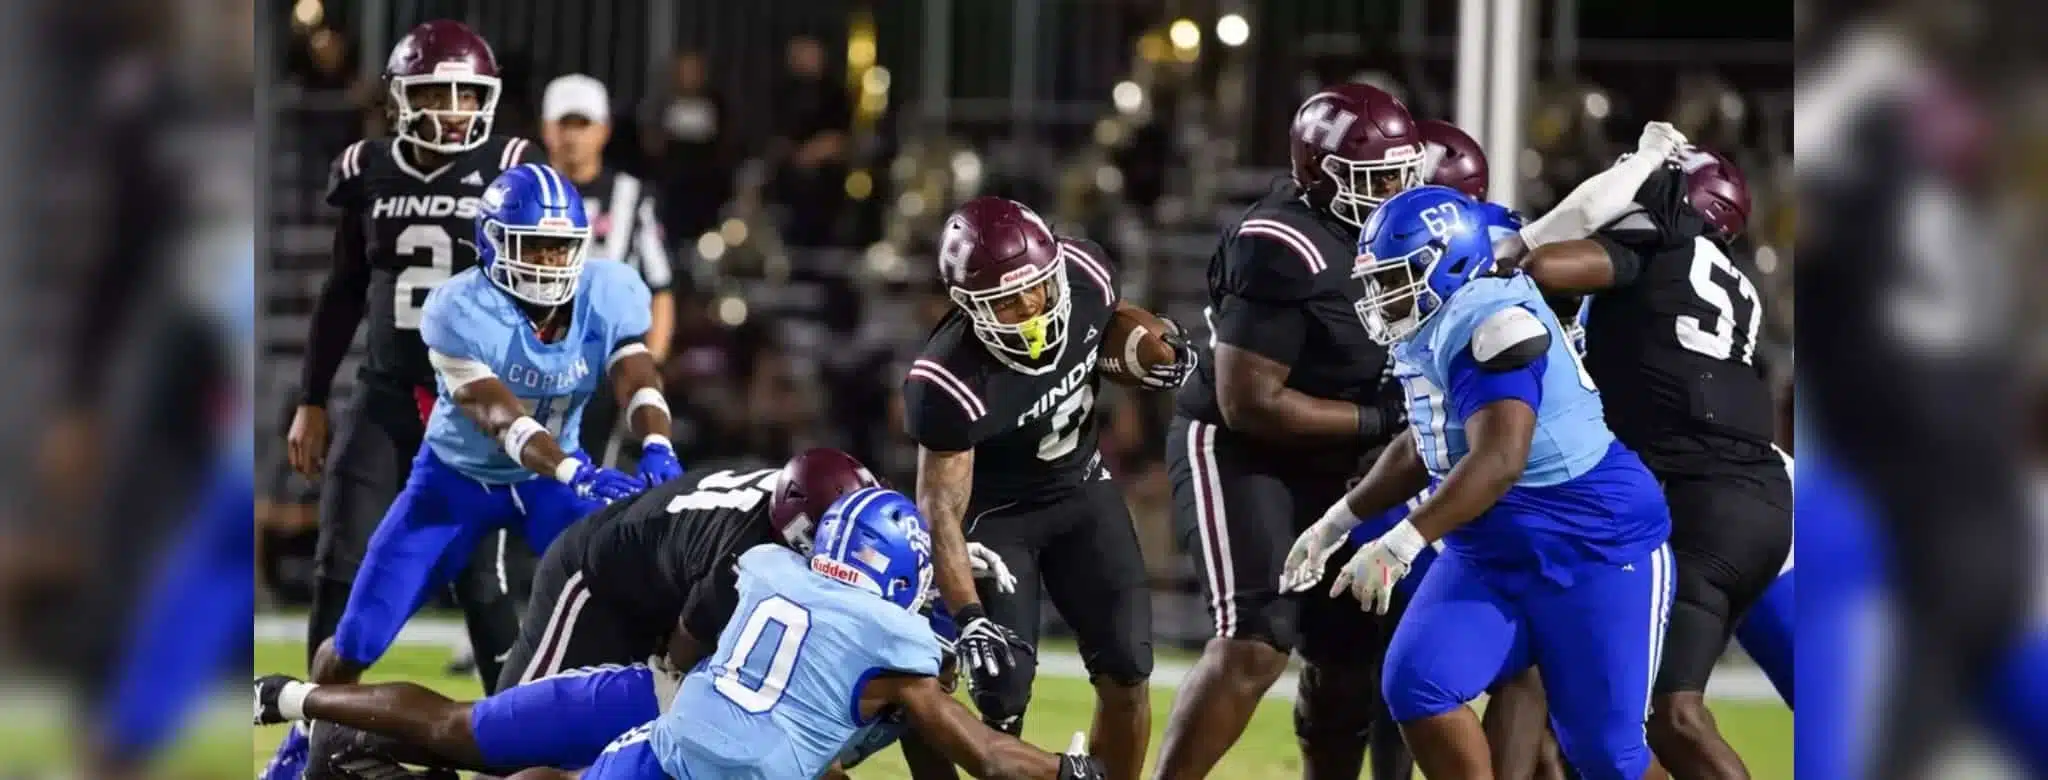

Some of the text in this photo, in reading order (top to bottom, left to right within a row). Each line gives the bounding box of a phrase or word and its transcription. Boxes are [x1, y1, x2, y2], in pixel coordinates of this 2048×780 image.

[372, 195, 481, 218] HINDS
[395, 224, 452, 329] 2
[1017, 345, 1098, 427] HINDS
[813, 558, 859, 584] Riddell
[712, 593, 812, 715] 0
